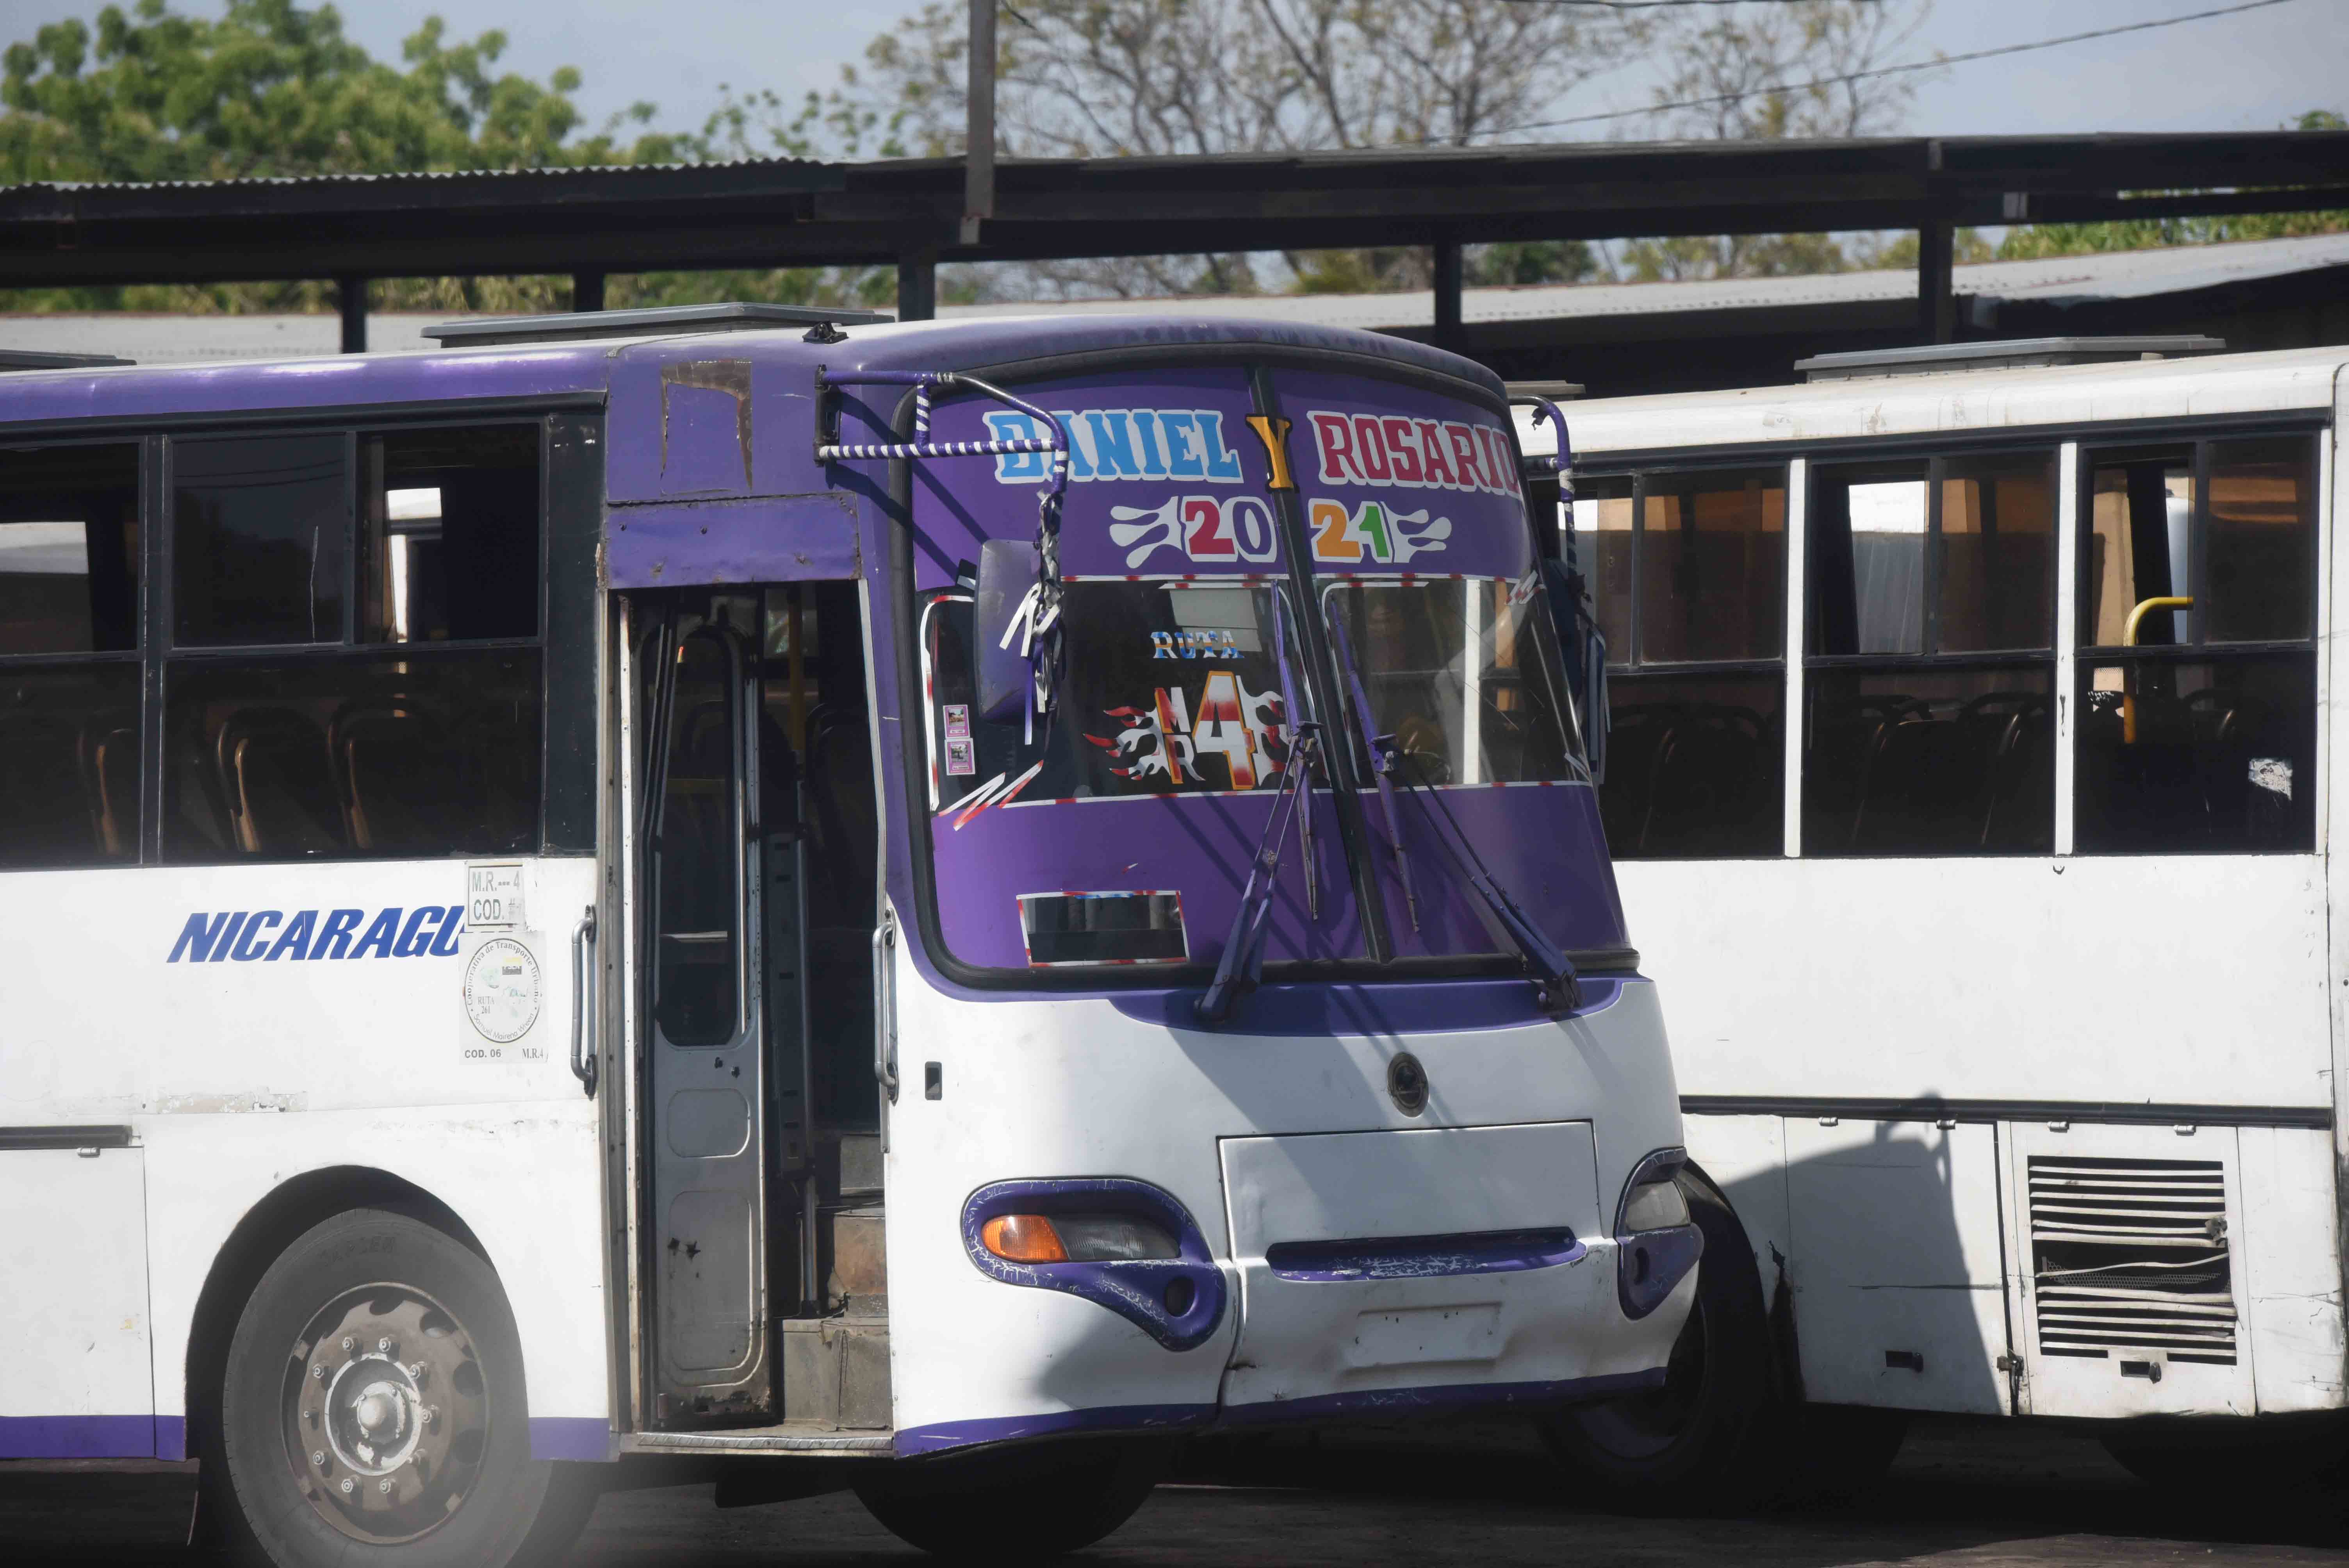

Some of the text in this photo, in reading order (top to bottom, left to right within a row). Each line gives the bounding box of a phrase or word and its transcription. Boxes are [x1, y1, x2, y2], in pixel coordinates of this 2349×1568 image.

[982, 409, 1522, 501] DANIEL Y ROSARIO
[1180, 495, 1392, 563] 20 21
[1150, 630, 1244, 659] RUTA
[474, 899, 504, 921] COD.
[485, 944, 494, 954] de
[478, 996, 495, 1005] RUTA
[465, 1049, 487, 1058] COD.
[490, 1049, 501, 1058] 06
